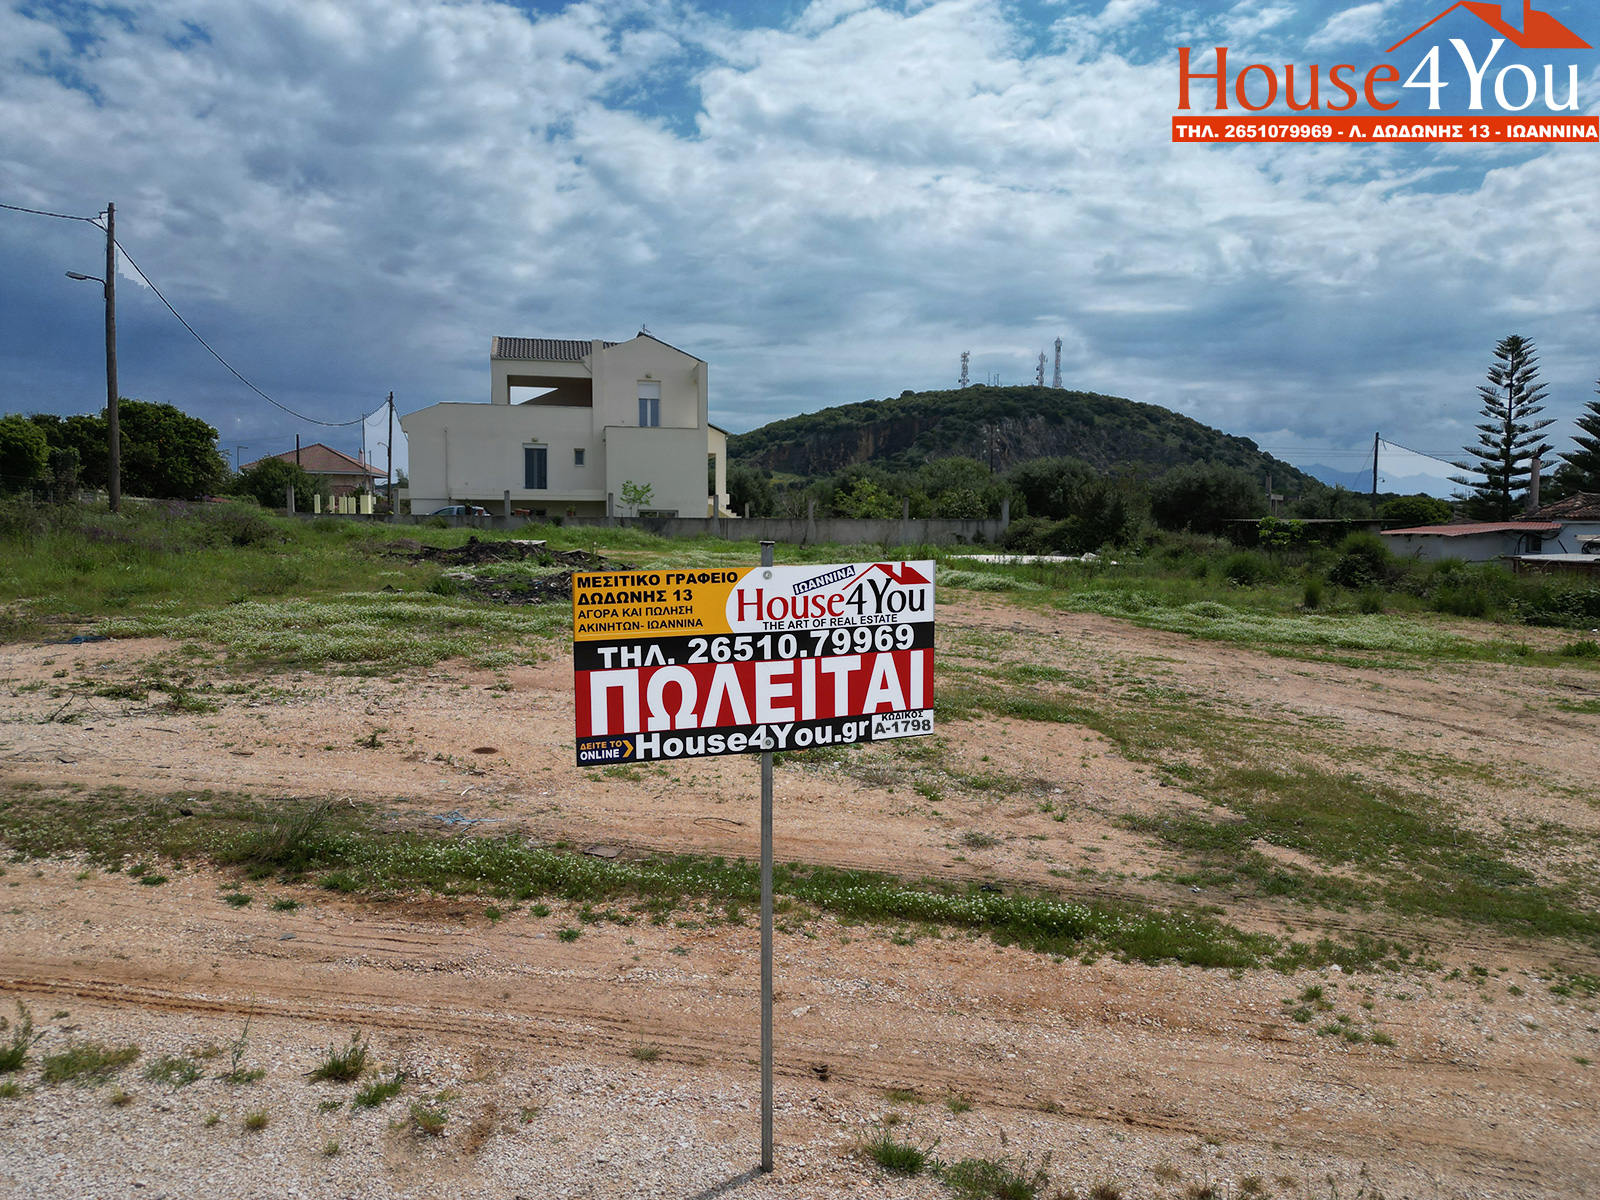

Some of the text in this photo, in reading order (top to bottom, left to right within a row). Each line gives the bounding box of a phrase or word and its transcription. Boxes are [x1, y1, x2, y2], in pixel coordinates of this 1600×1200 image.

[577, 572, 738, 588] ΜΕΣΙΤΙΚΟ ΓΡΑΦΕΙΟ
[794, 566, 855, 595] ΙΩΑΝΝΙΝΑ
[577, 589, 693, 605] ΔΩΔΩΝΗΣ 13
[737, 577, 925, 622] House4You
[578, 605, 693, 619] ΑΓΟΡΑ ΚΑΙ ΠΩΛΗΣΗ
[647, 618, 703, 630] ΙΩΑΝΝΙΝΑ
[763, 614, 898, 630] THE ART OF REAL ESTATE
[597, 623, 915, 669] ΤΗΛ. 26510.79969
[589, 649, 924, 736] ΠΩΛΕΙΤΑΙ
[882, 710, 924, 721] ΚΩΔΙΚΟΣ
[580, 740, 623, 750] ΔΕΙΤΕ ΤΟ
[635, 719, 870, 760] House4You.gr
[580, 749, 620, 761] ONLINE
